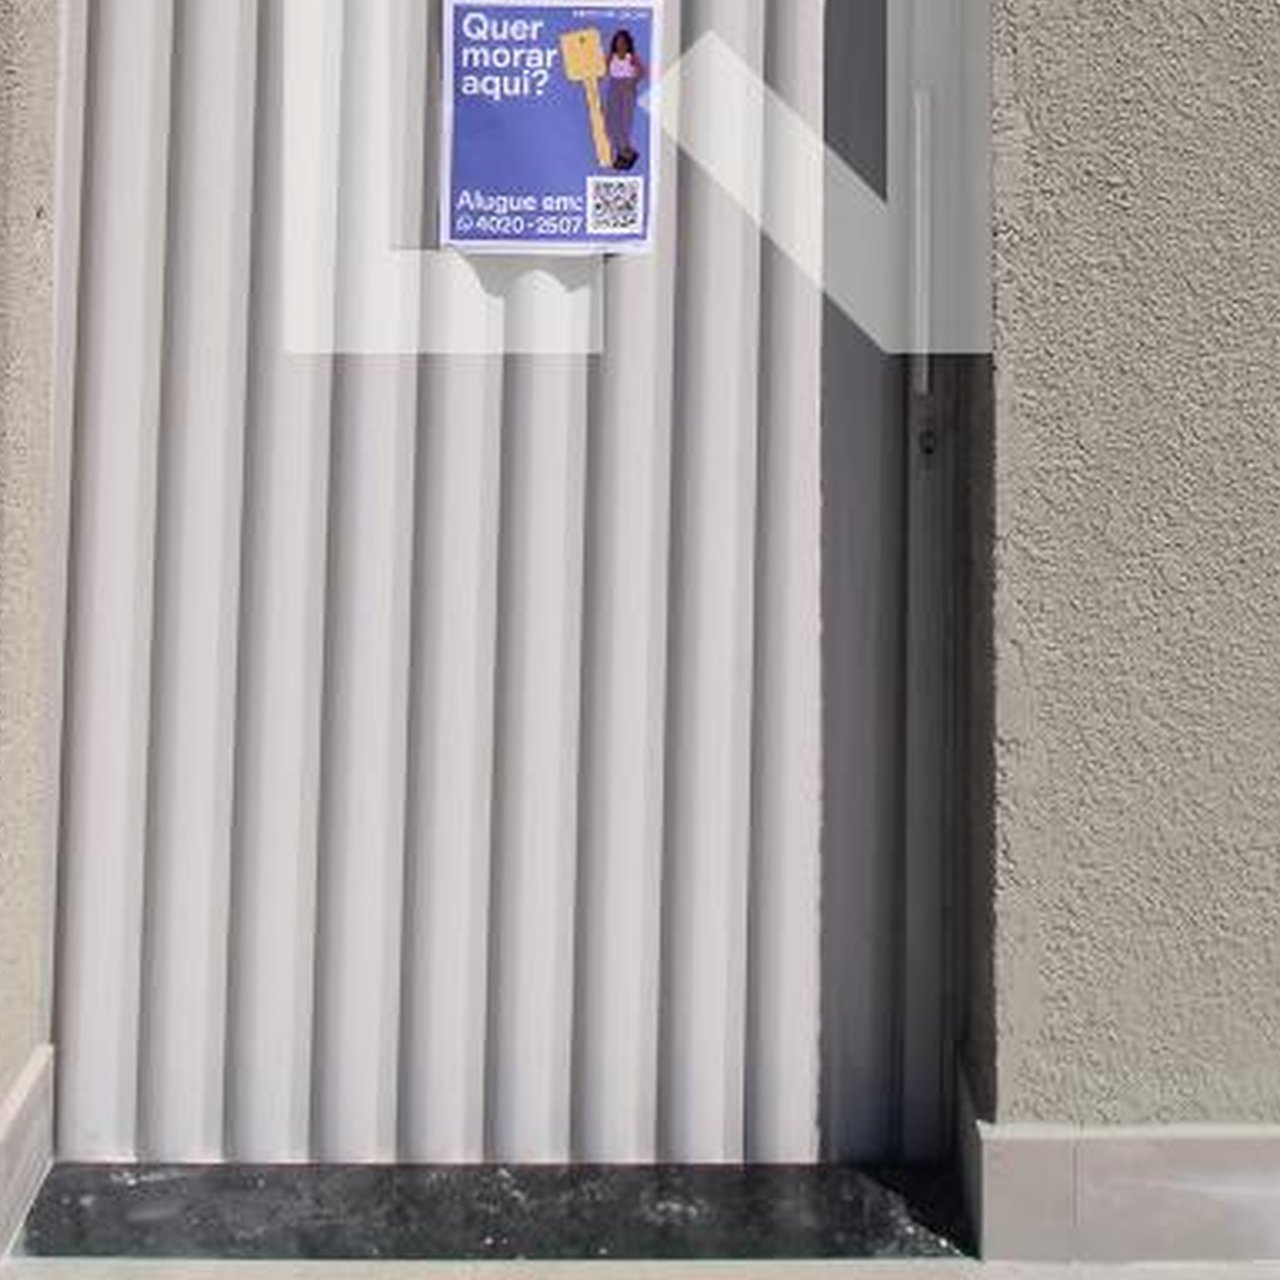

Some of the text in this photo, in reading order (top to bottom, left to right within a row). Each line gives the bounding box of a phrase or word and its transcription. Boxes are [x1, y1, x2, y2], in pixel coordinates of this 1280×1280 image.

[462, 13, 543, 42] Quer
[462, 48, 558, 68] morar
[462, 69, 549, 100] aqui?
[456, 190, 537, 214] Alugue
